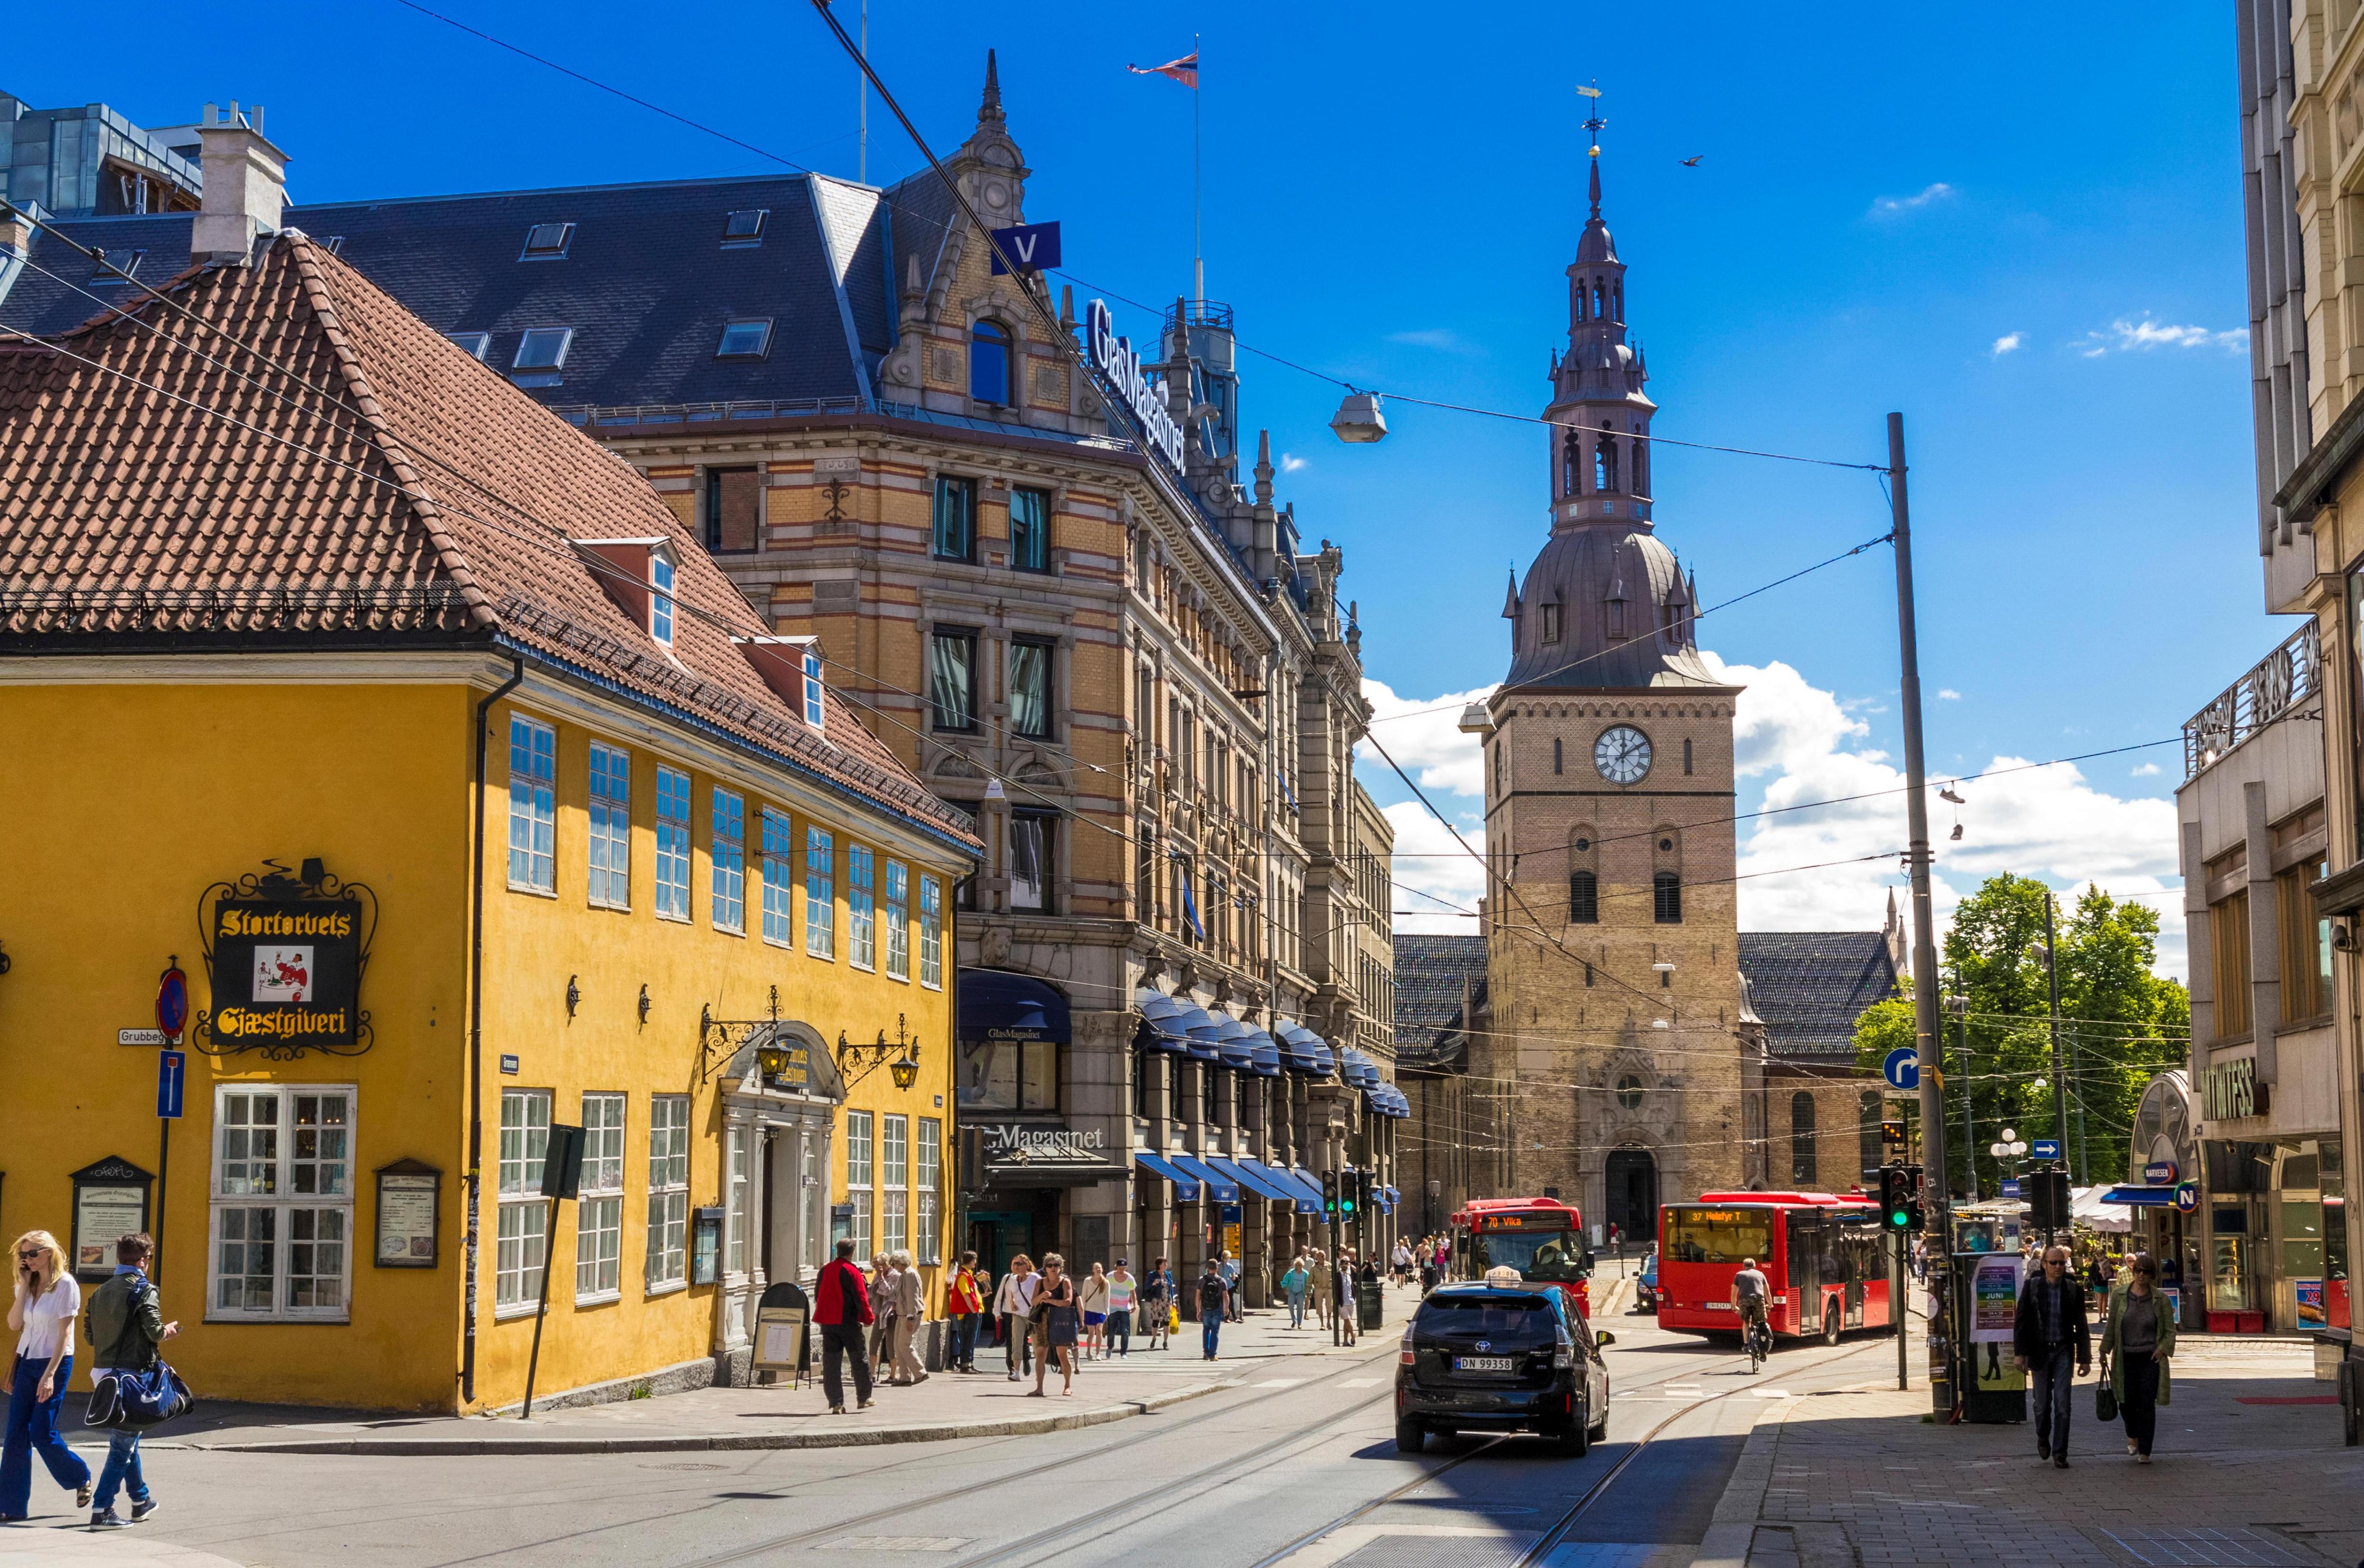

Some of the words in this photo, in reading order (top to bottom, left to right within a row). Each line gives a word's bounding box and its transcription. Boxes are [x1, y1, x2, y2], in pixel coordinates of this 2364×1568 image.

[1014, 234, 1037, 262] V
[1089, 298, 1186, 477] GlasMagasinet
[219, 909, 351, 939] Stortorvets
[218, 1007, 346, 1040] Gjæstgiveri
[988, 1029, 1040, 1040] GlasMagasinet
[2146, 1169, 2169, 1177] NARVESEN
[2180, 1190, 2194, 1204] N
[1488, 1217, 1498, 1228] 70
[1503, 1217, 1521, 1226] Vika
[1692, 1213, 1702, 1221] 37
[1706, 1212, 1732, 1222] Helsfyr
[1735, 1212, 1741, 1220] T
[2306, 1291, 2320, 1303] 29
[1462, 1359, 1475, 1368] DN
[1480, 1359, 1510, 1369] 99358
